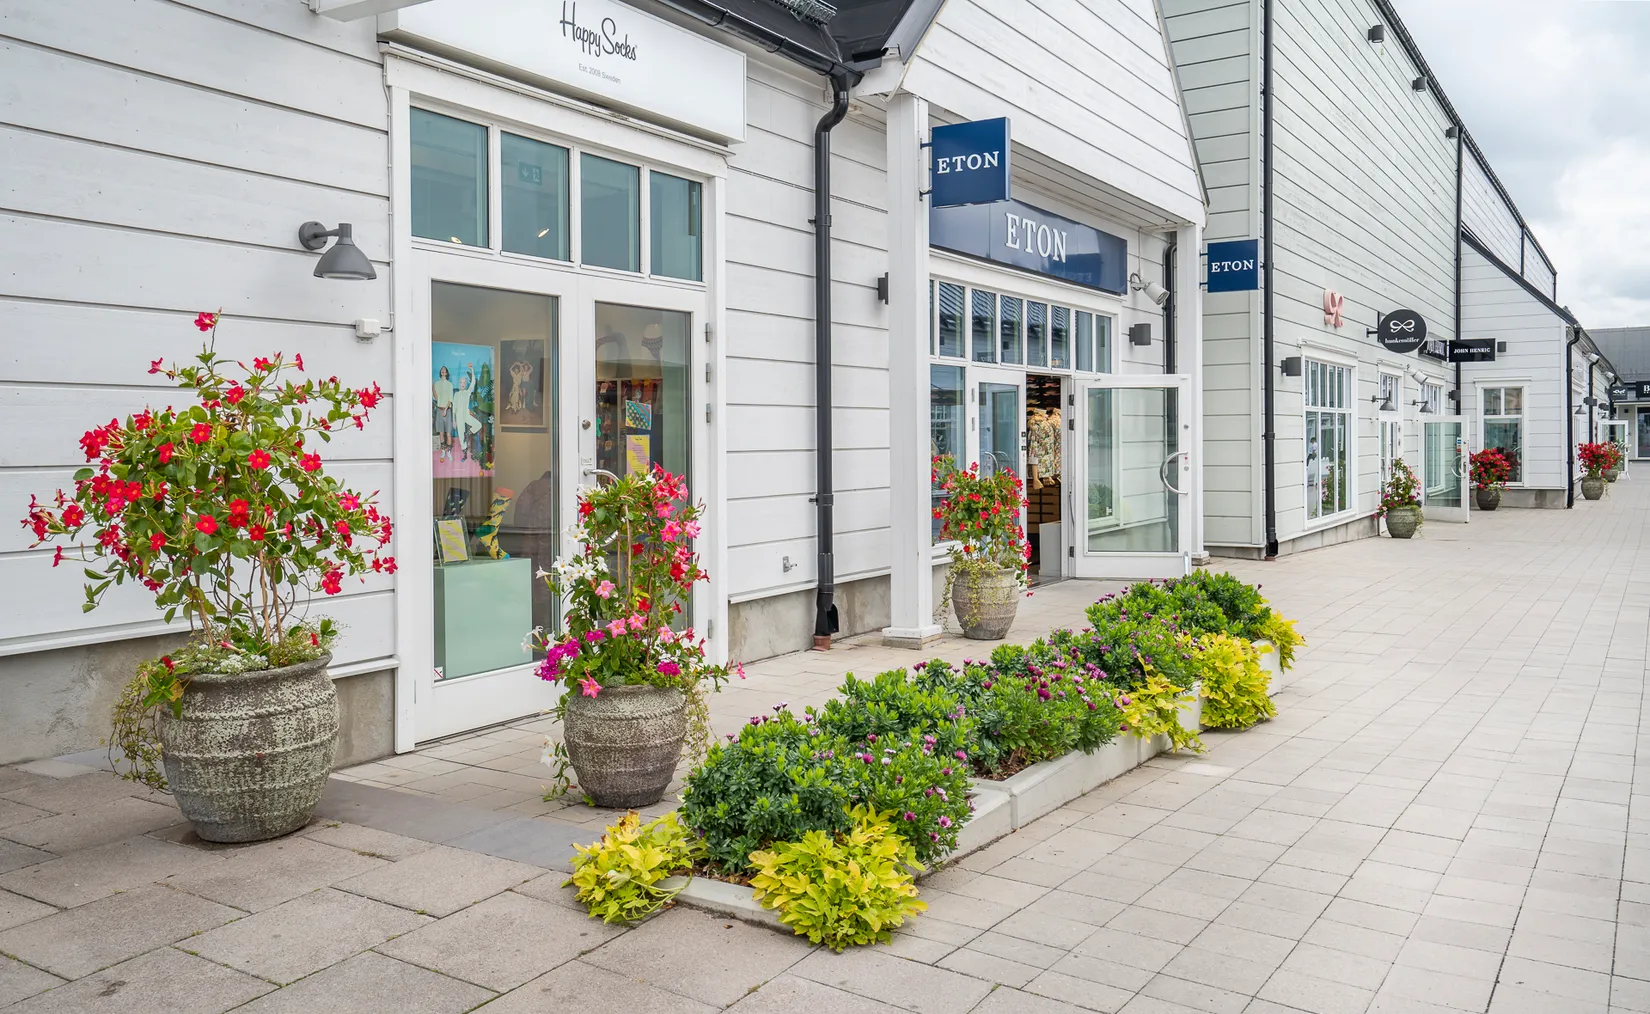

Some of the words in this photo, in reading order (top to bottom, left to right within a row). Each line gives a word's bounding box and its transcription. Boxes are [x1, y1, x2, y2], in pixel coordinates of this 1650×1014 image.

[559, 0, 601, 57] Happy
[601, 17, 636, 61] Socks
[936, 151, 999, 174] ETON
[1005, 212, 1066, 263] ETON
[1211, 259, 1254, 273] ETON
